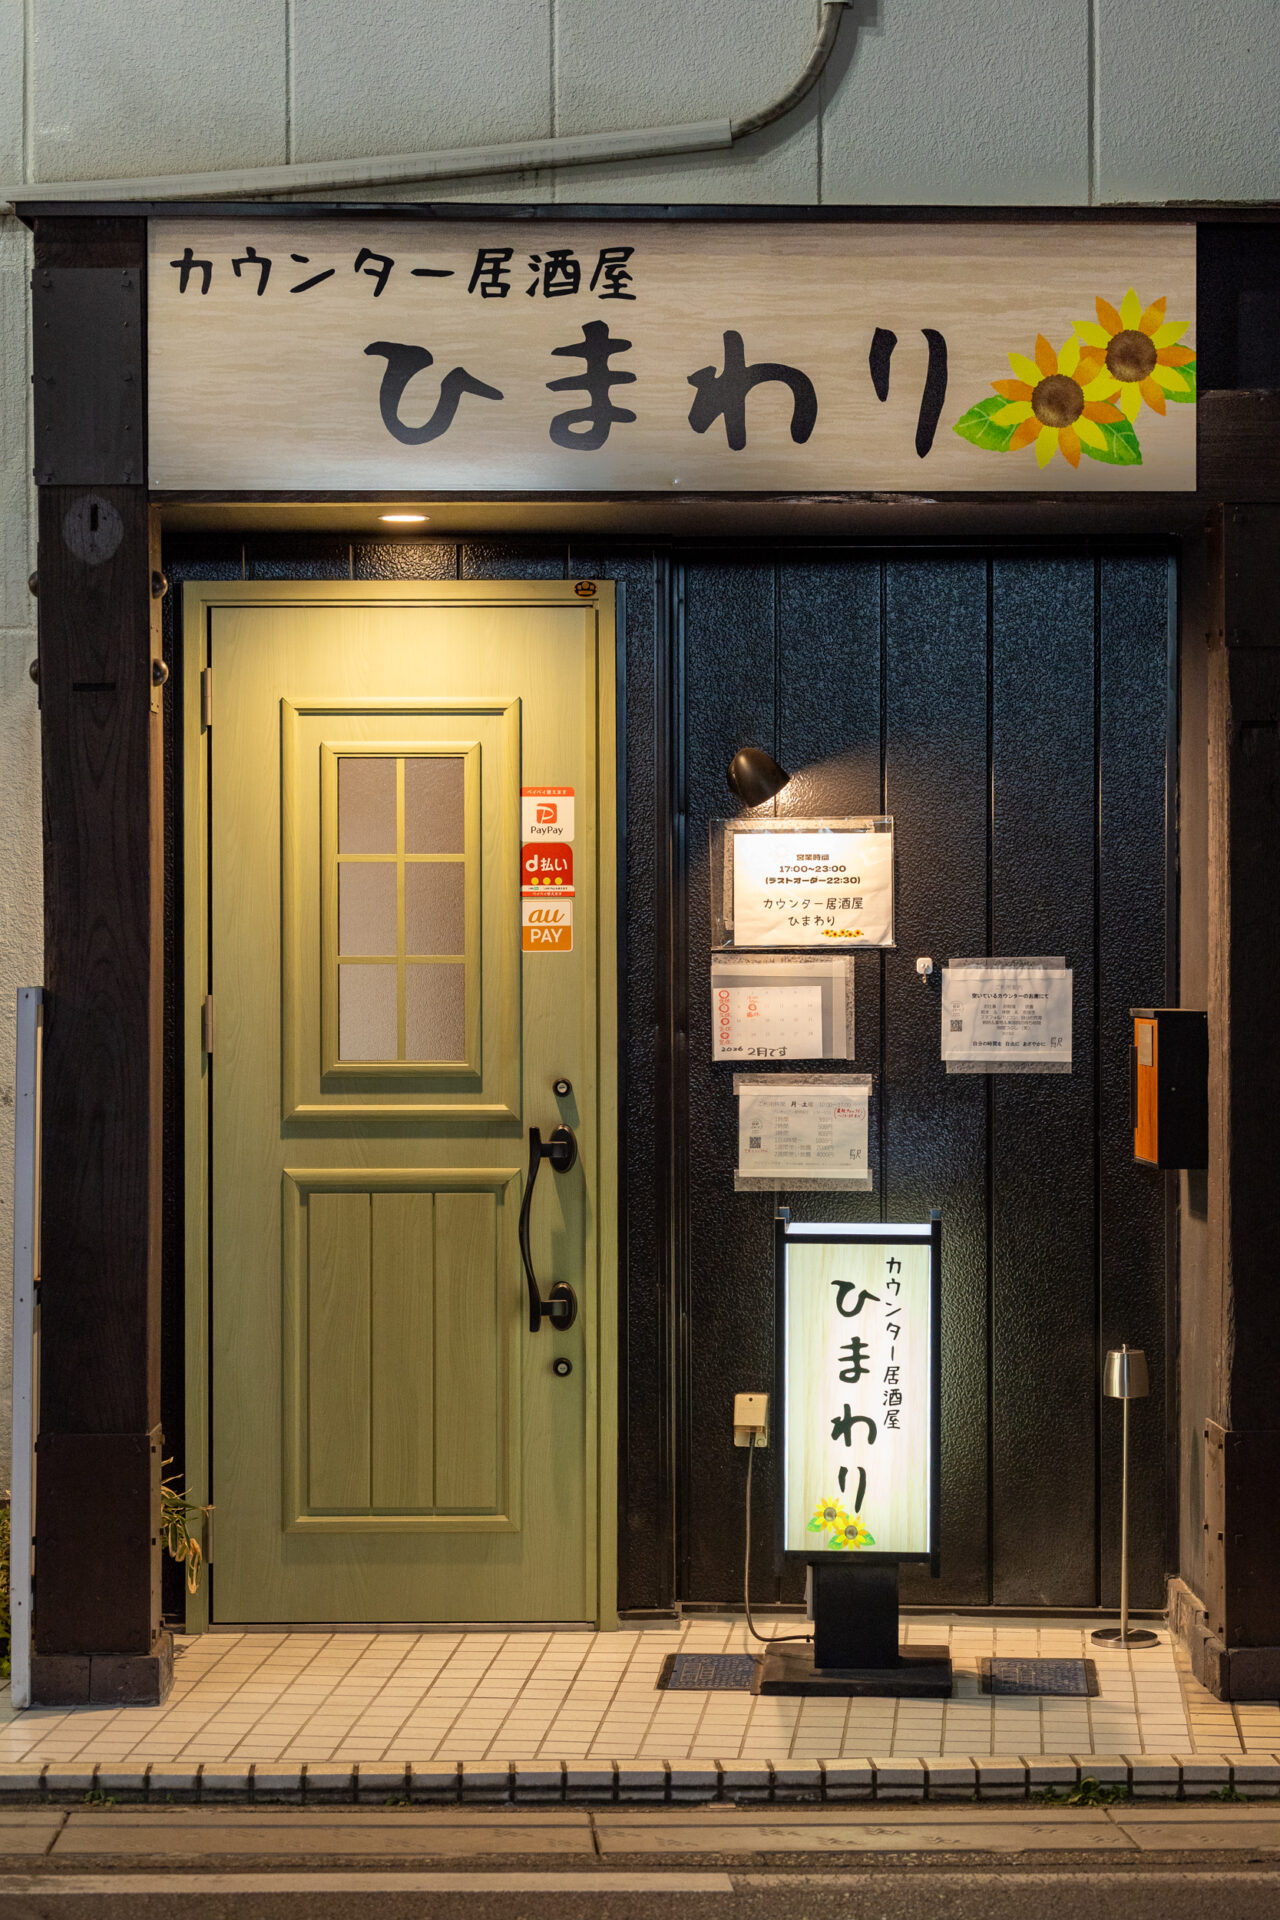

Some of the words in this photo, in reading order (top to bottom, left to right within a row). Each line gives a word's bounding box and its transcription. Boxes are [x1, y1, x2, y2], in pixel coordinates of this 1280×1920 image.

[170, 247, 637, 300] カウンター居酒屋
[364, 320, 948, 459] ひまわり
[530, 826, 564, 836] PayPay
[525, 854, 568, 872] d払い
[763, 897, 864, 910] カウンター居酒屋
[528, 908, 565, 924] au
[788, 914, 835, 926] ひまわり
[530, 928, 563, 943] PAY
[747, 1045, 788, 1058] 2月です
[883, 1257, 903, 1430] カウンター居酒屋
[830, 1279, 881, 1514] ひまわり
